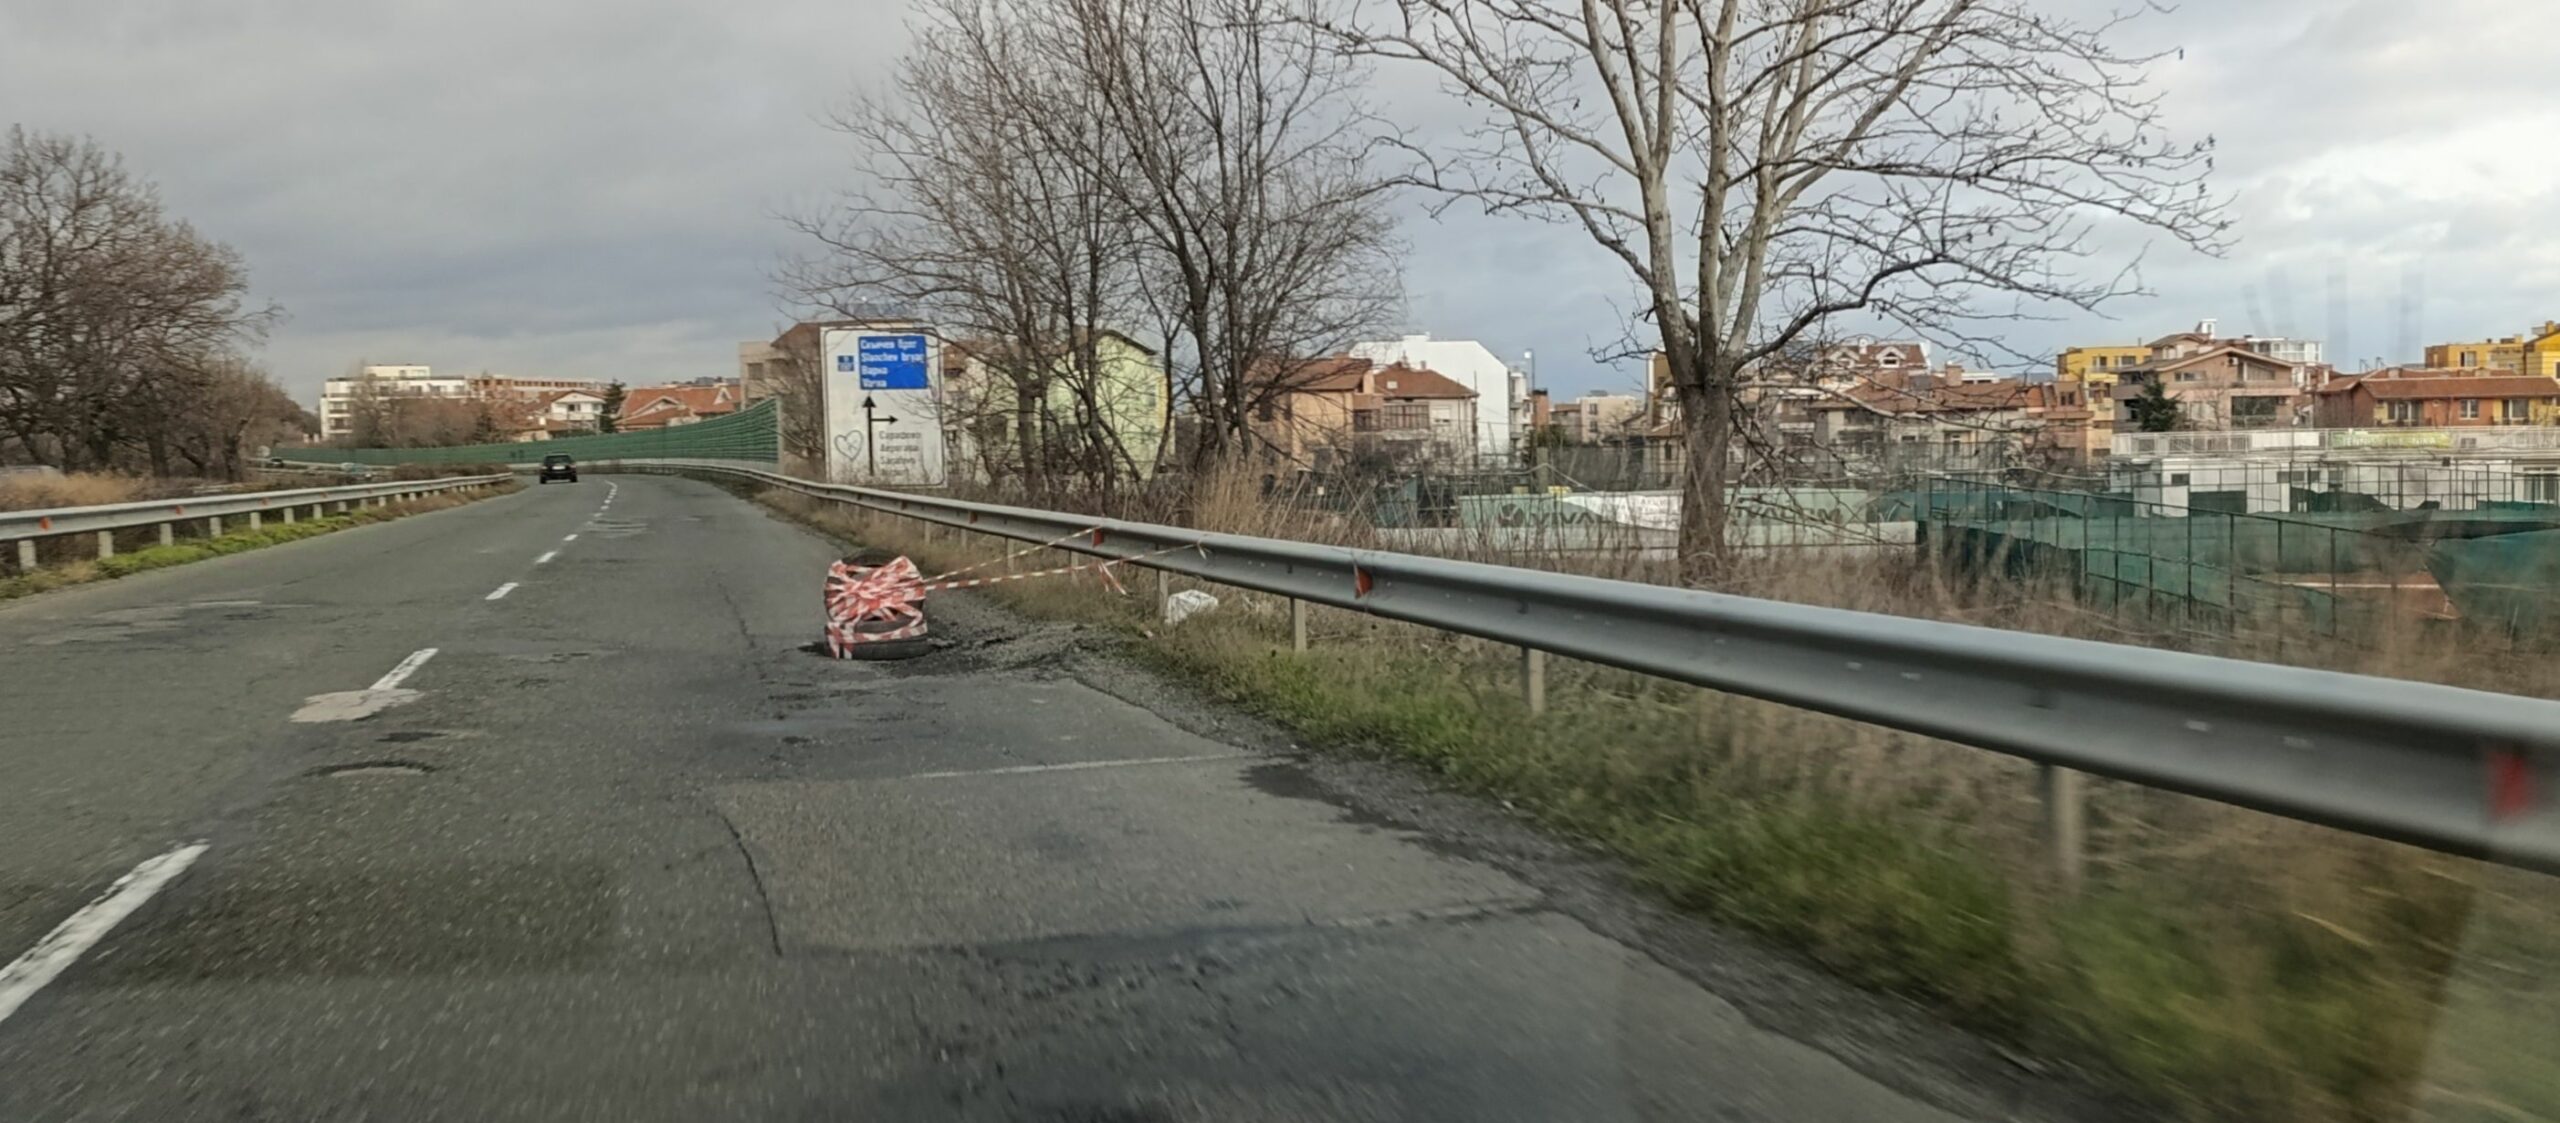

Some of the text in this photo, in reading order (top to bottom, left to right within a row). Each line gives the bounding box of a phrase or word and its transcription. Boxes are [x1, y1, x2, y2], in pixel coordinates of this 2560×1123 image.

[861, 352, 898, 362] Slanchev
[862, 365, 889, 377] Варна
[863, 378, 888, 388] Varna
